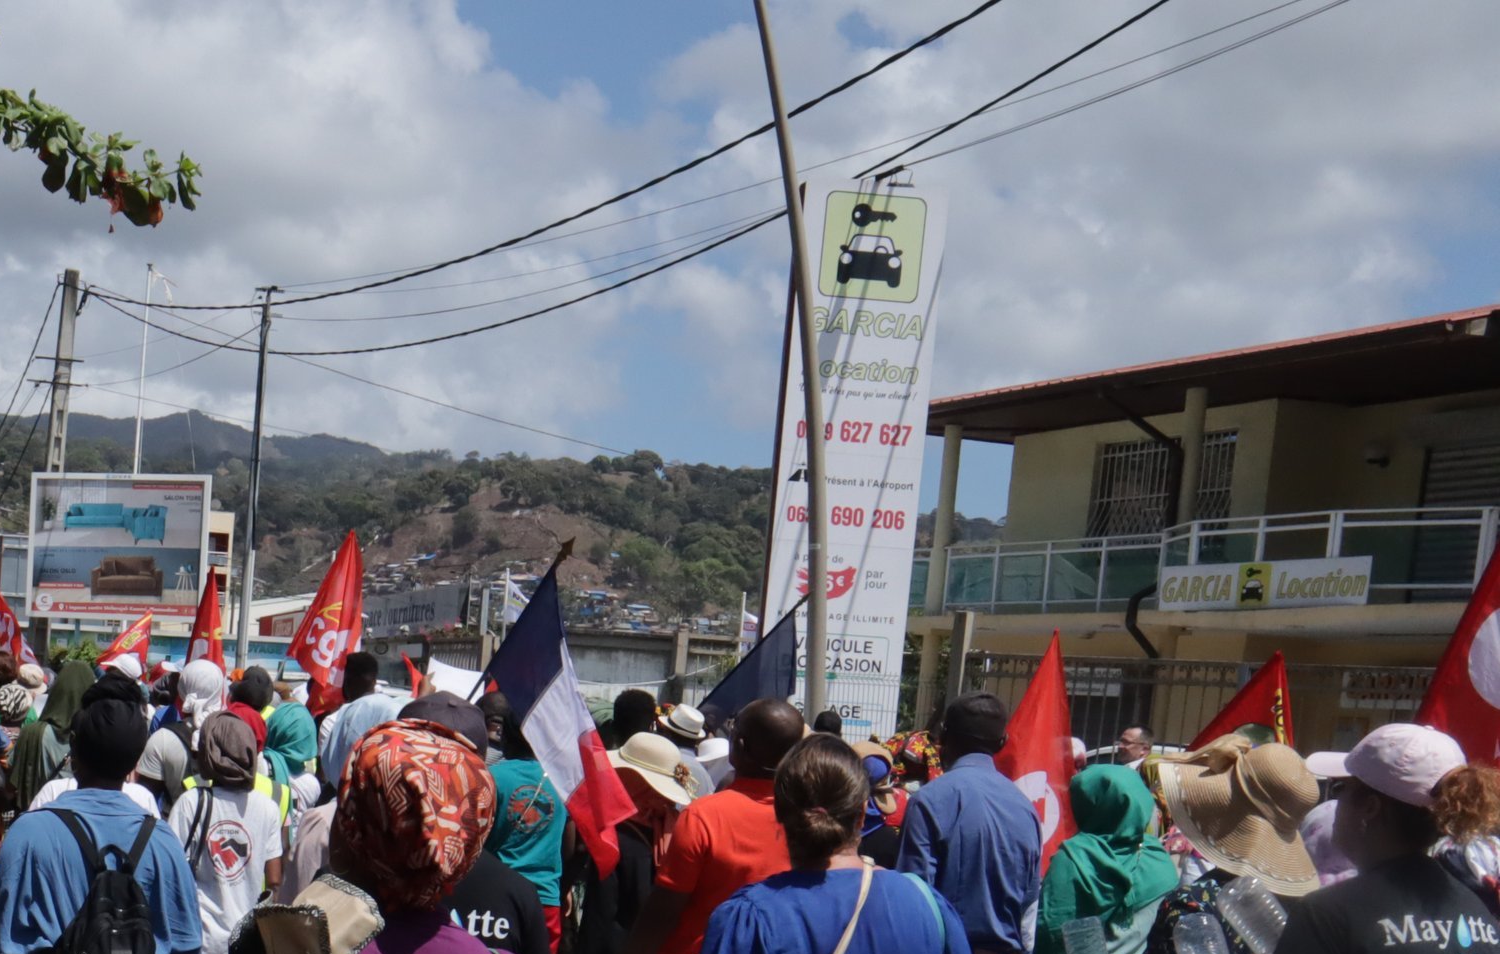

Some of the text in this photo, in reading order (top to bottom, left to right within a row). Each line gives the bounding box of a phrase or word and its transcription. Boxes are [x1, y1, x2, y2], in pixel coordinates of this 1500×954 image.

[812, 306, 923, 341] GARCIA
[818, 358, 919, 384] ocation
[840, 420, 873, 443] 627
[879, 423, 913, 446] 627
[831, 505, 864, 527] 690
[872, 508, 906, 530] 206
[864, 579, 887, 590] jour
[866, 570, 884, 580] par
[1162, 567, 1368, 603] GARCIA Location
